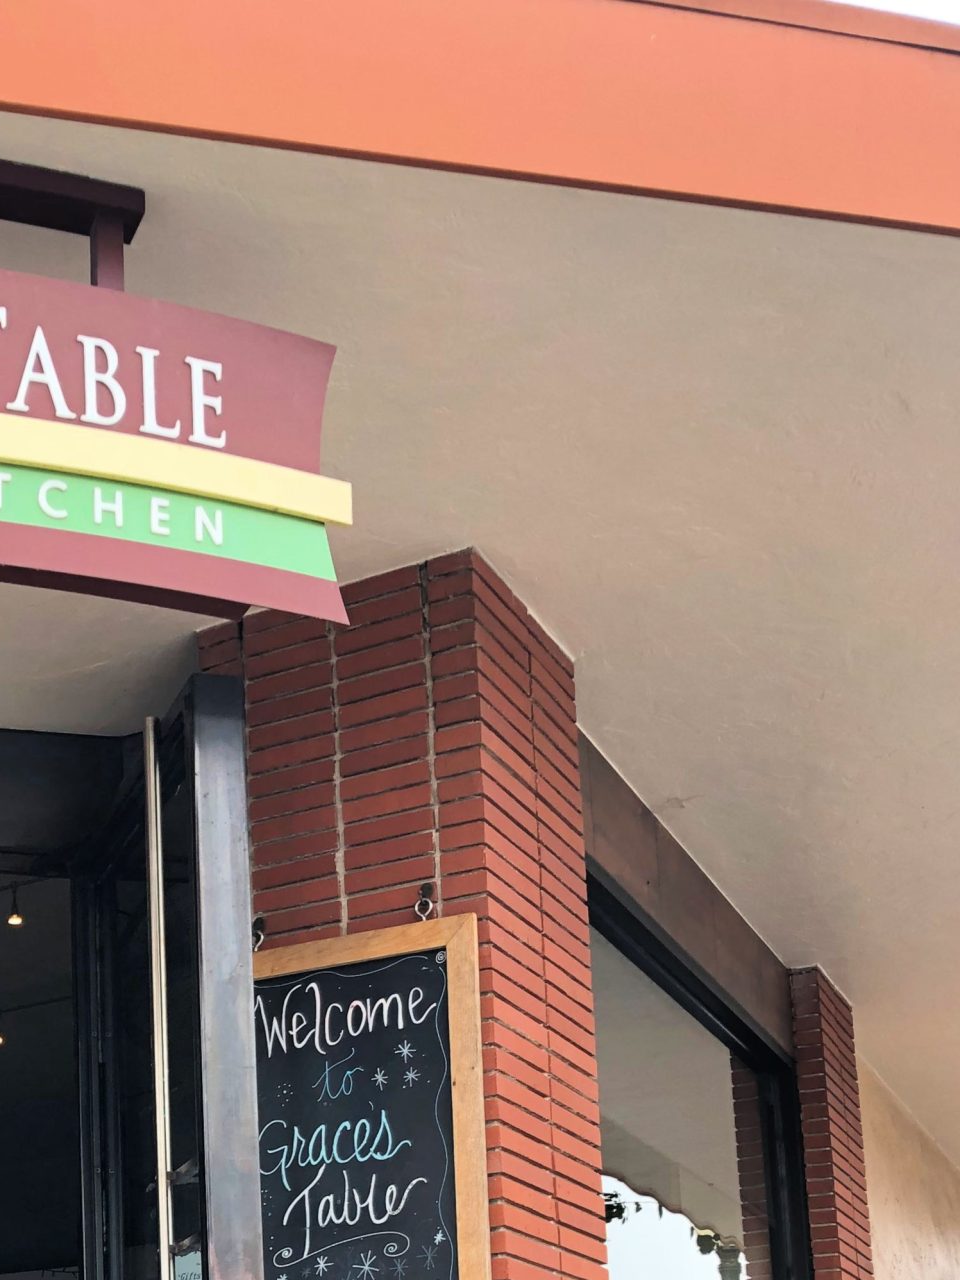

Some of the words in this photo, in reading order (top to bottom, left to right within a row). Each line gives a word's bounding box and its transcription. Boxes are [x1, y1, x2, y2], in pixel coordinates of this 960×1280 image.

[254, 981, 437, 1058] Welcome
[311, 1048, 365, 1102] to
[282, 1163, 429, 1259] Table
